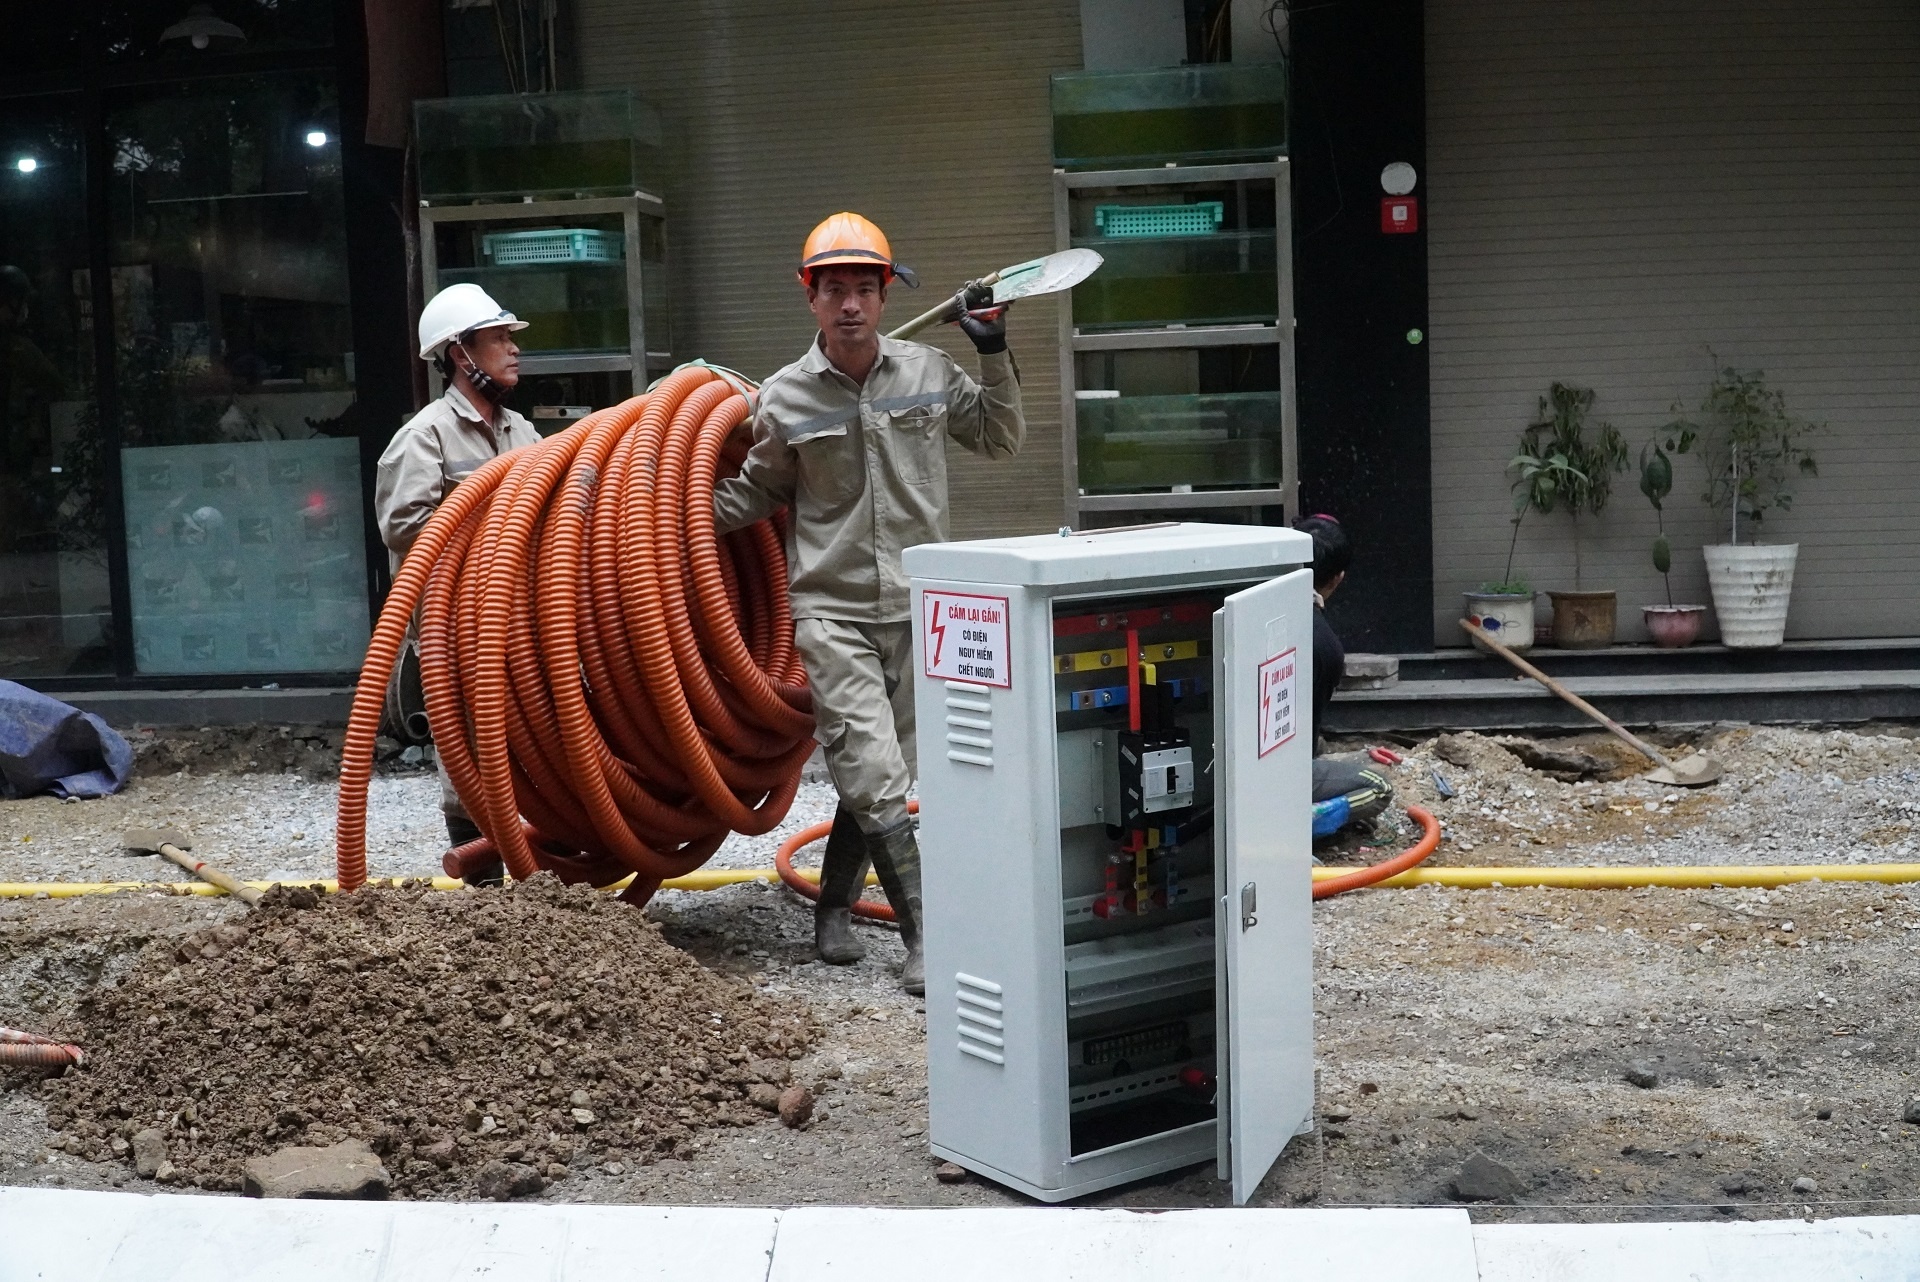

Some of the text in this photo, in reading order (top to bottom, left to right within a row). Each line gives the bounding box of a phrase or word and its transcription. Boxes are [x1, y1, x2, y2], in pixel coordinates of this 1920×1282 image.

[948, 603, 966, 620] CẤM
[968, 608, 979, 624] LẠI
[962, 629, 971, 640] CÓ
[958, 646, 993, 661] NGUY HIỂM
[958, 662, 994, 679] CHẾT NGƯỜI
